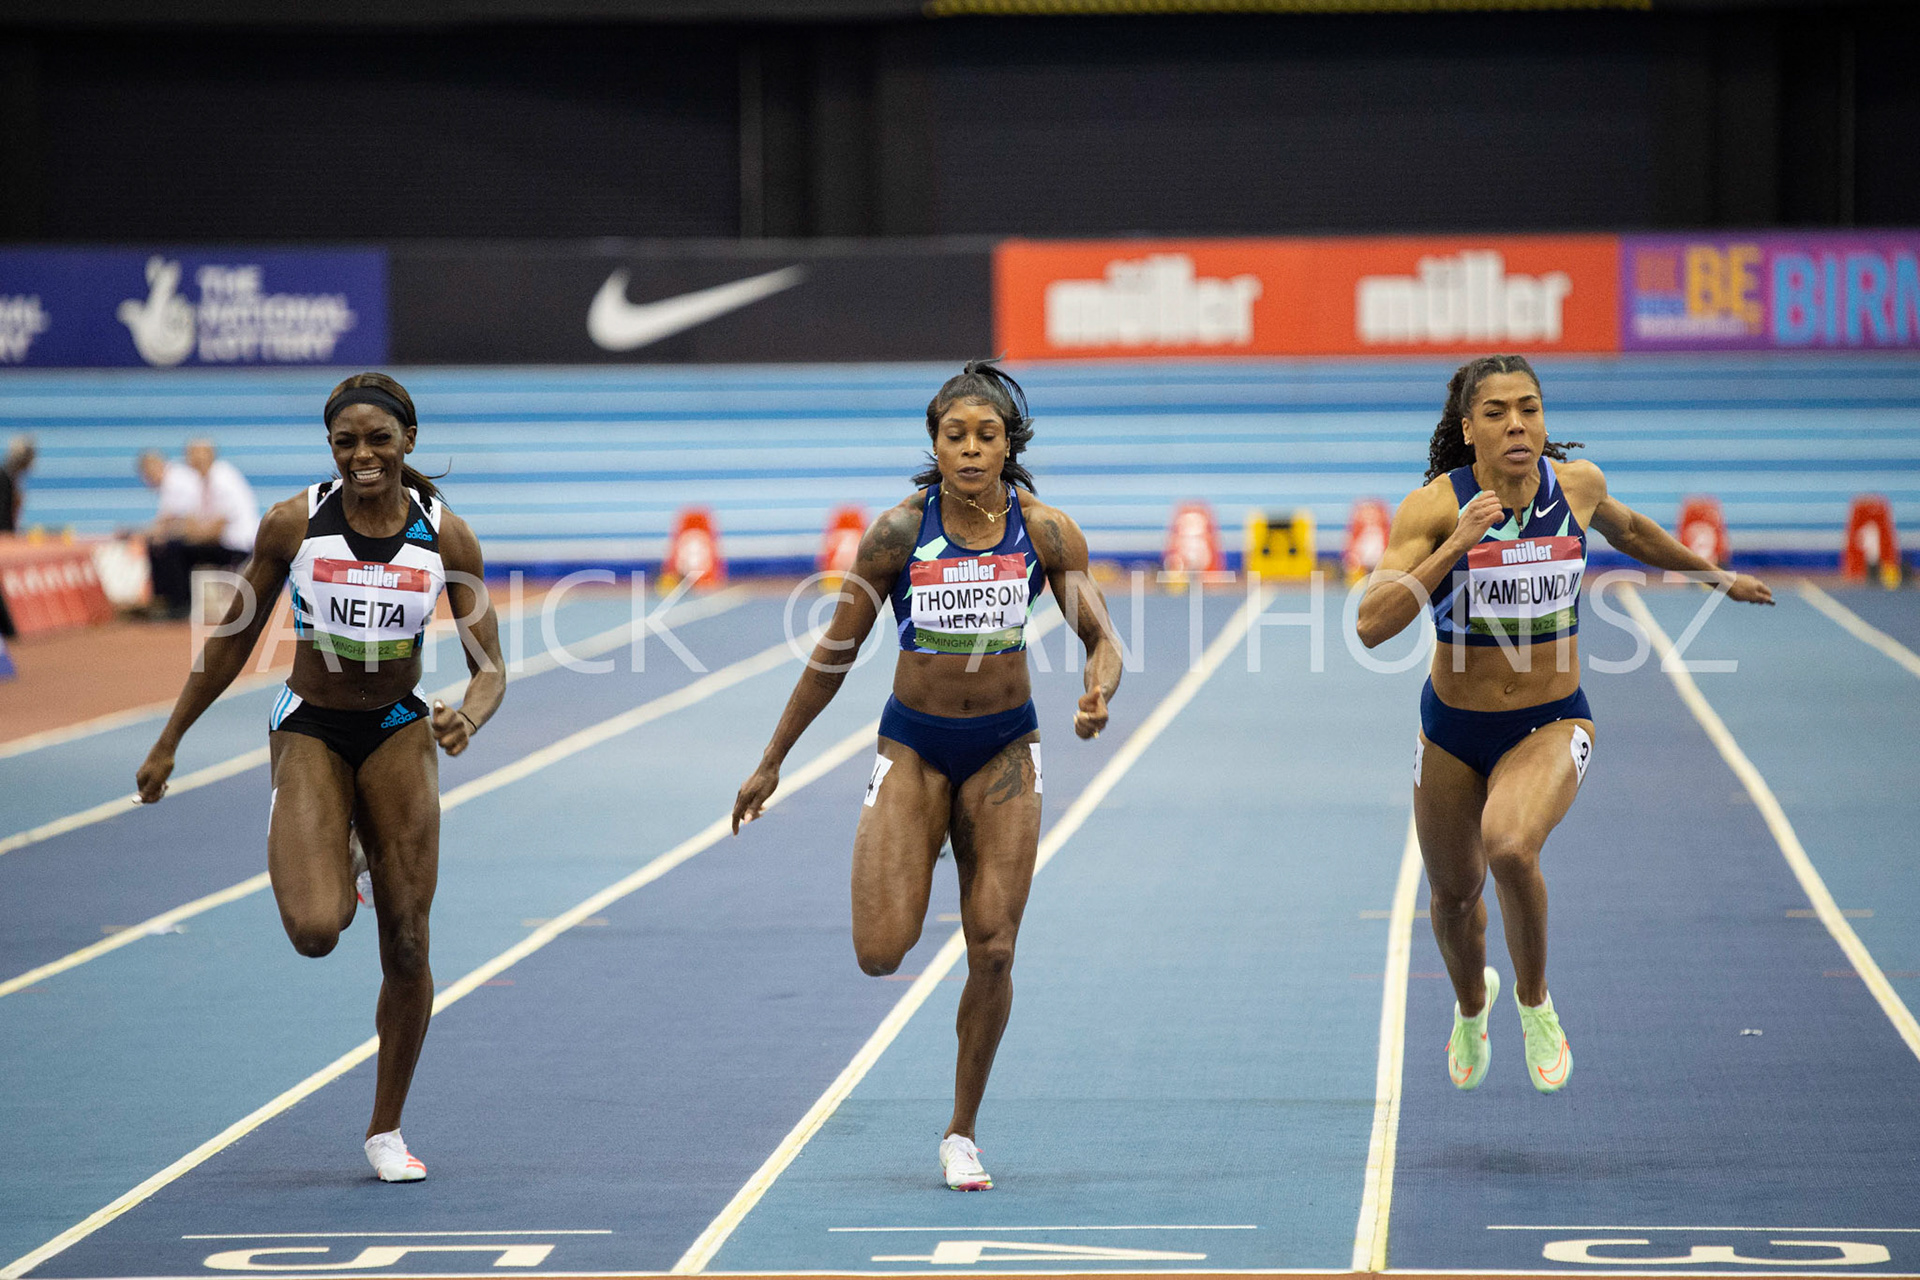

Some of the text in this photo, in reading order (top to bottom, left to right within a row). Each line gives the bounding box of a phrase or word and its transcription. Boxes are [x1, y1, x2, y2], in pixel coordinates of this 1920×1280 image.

[405, 531, 433, 542] adidas
[1501, 541, 1552, 565] müller
[346, 564, 401, 588] müller
[943, 559, 996, 583] müller
[917, 585, 1023, 611] THOMPSON
[1473, 572, 1580, 604] KAMBUNDJI
[330, 597, 405, 628] NEITA
[939, 611, 1004, 629] HERAH
[1471, 618, 1555, 632] BIRMINGHAM 22
[378, 646, 390, 655] 22
[918, 632, 999, 648] BIRMINGHAM 22
[380, 711, 418, 729] adidas
[203, 1244, 555, 1271] 5
[871, 1240, 1207, 1264] 4
[1542, 1239, 1891, 1265] 3
